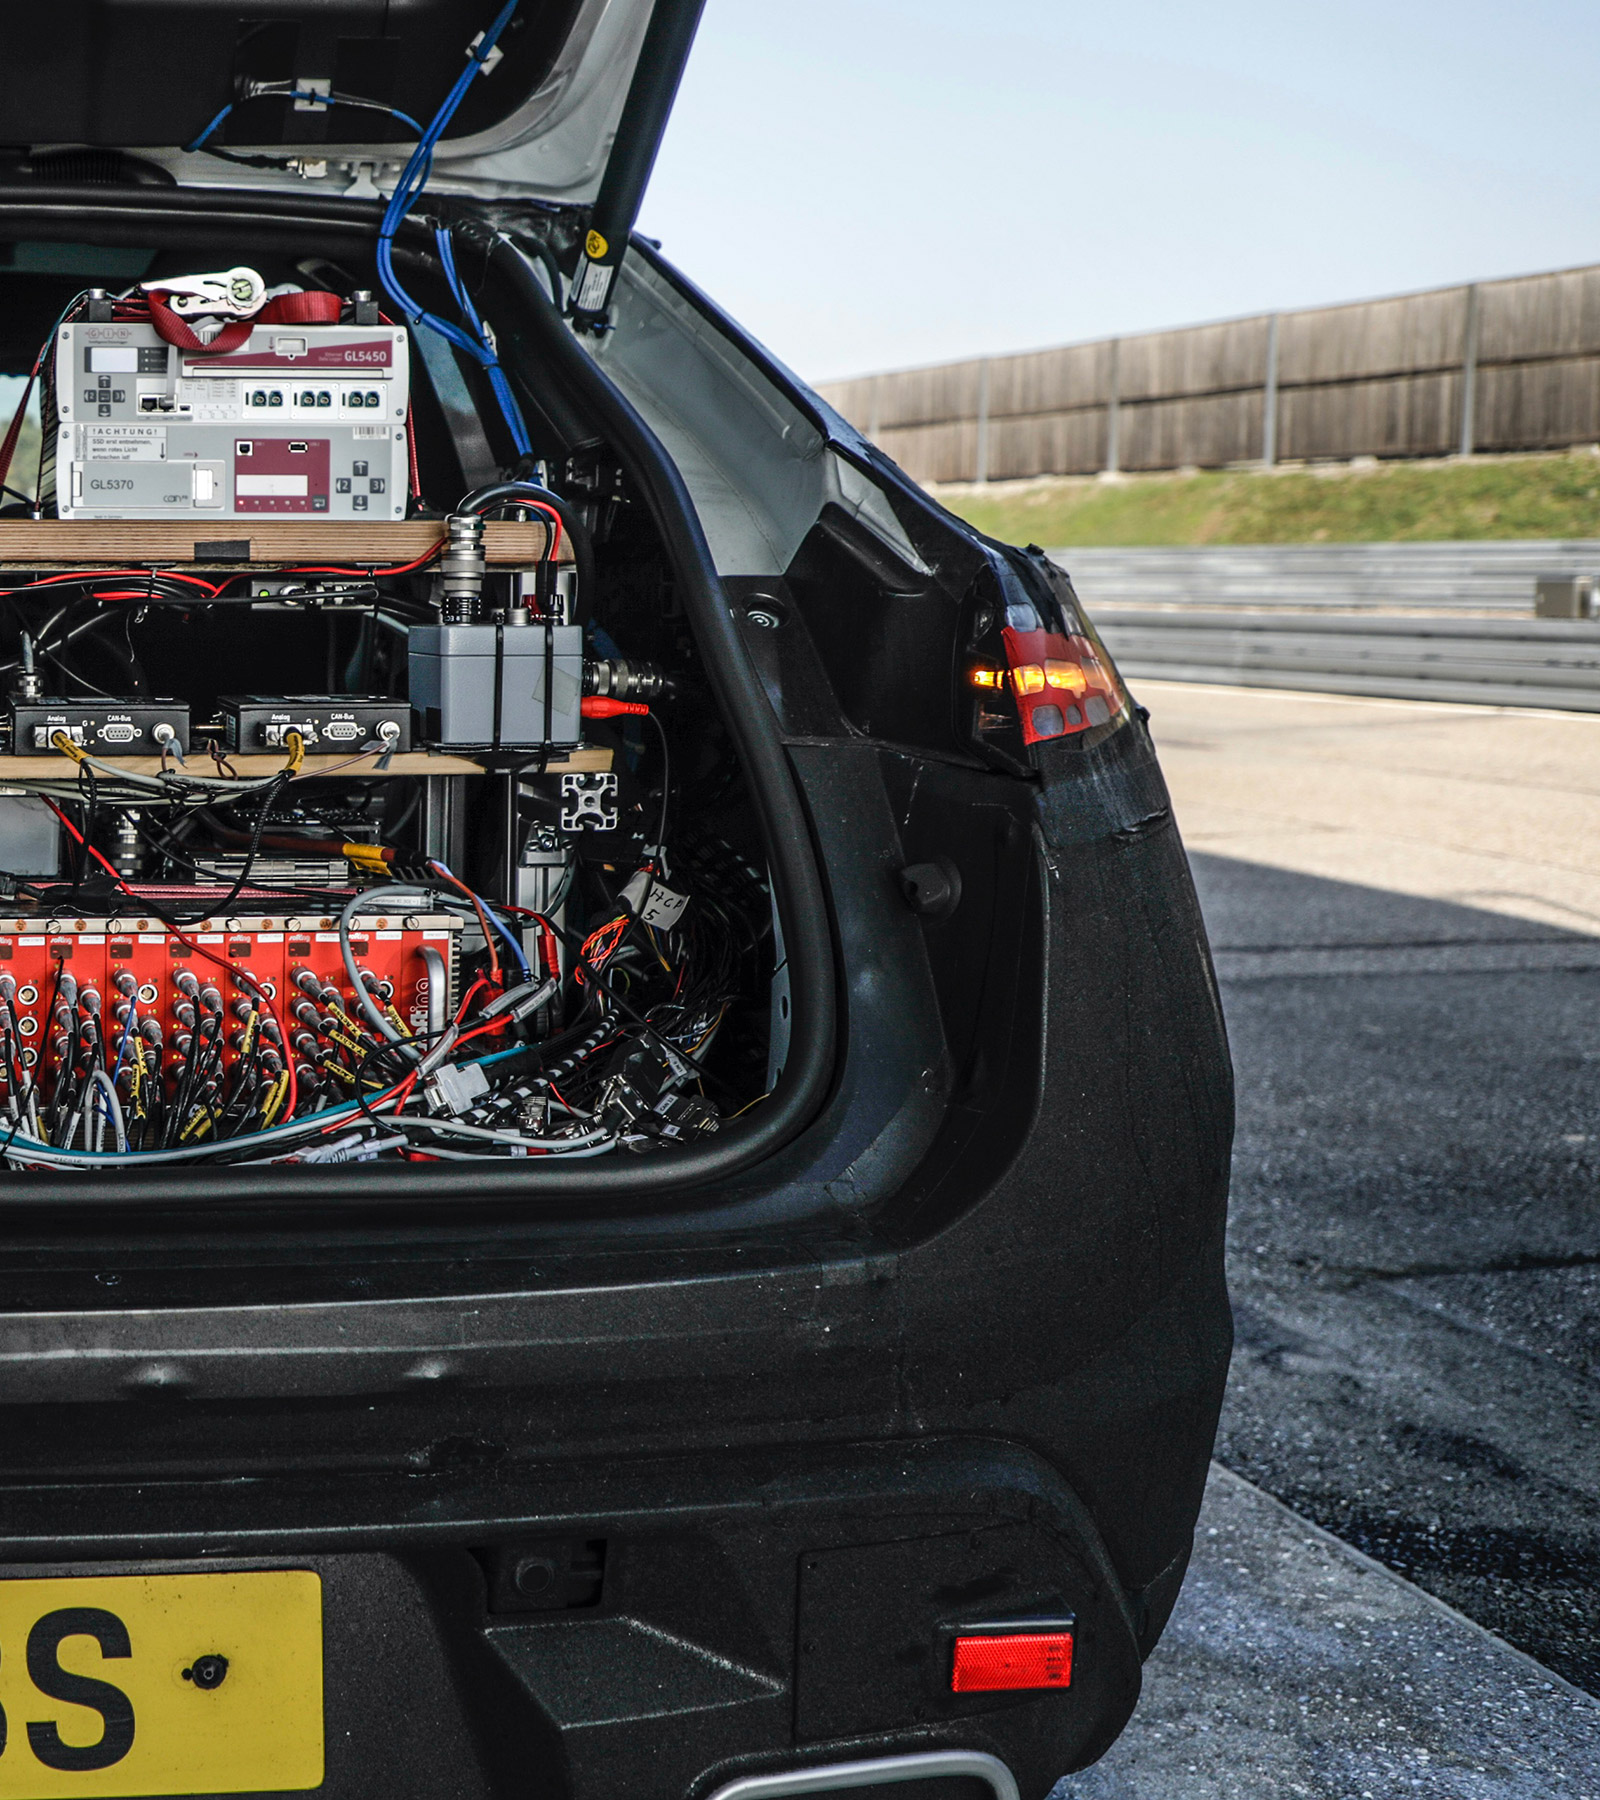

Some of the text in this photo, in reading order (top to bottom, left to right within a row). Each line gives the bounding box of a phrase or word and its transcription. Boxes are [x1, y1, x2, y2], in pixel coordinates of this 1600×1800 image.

[344, 351, 387, 362] GL5450
[90, 480, 134, 490] GL5370
[342, 480, 379, 489] 2 3
[357, 496, 363, 505] 4
[47, 715, 67, 723] Analog
[271, 714, 291, 722] Analog
[644, 908, 660, 920] 5
[50, 936, 73, 945] softing
[110, 935, 133, 944] softing
[229, 935, 251, 943] softing
